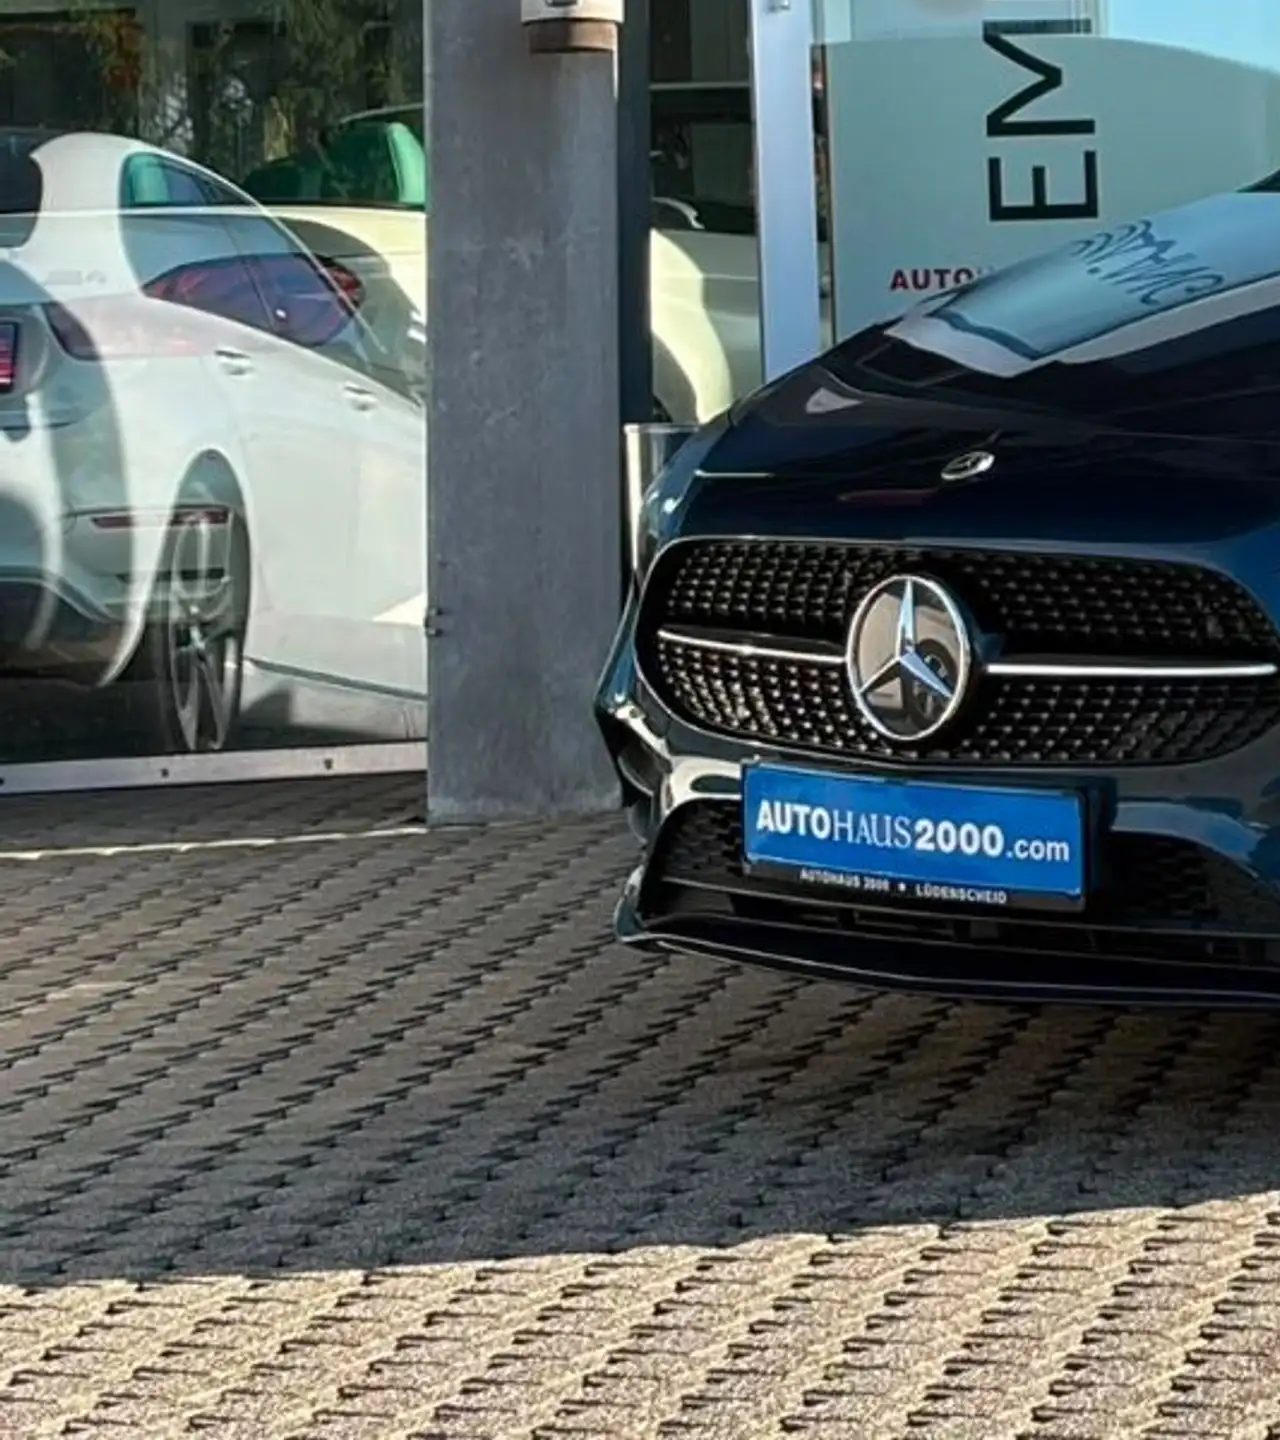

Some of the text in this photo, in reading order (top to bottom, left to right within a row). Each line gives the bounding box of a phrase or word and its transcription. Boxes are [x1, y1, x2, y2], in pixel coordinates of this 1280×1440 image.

[757, 798, 1070, 862] AUTOHAUS2000.com
[800, 868, 1008, 904] AUTOHAUS 2000 LÜDENSCHEID
